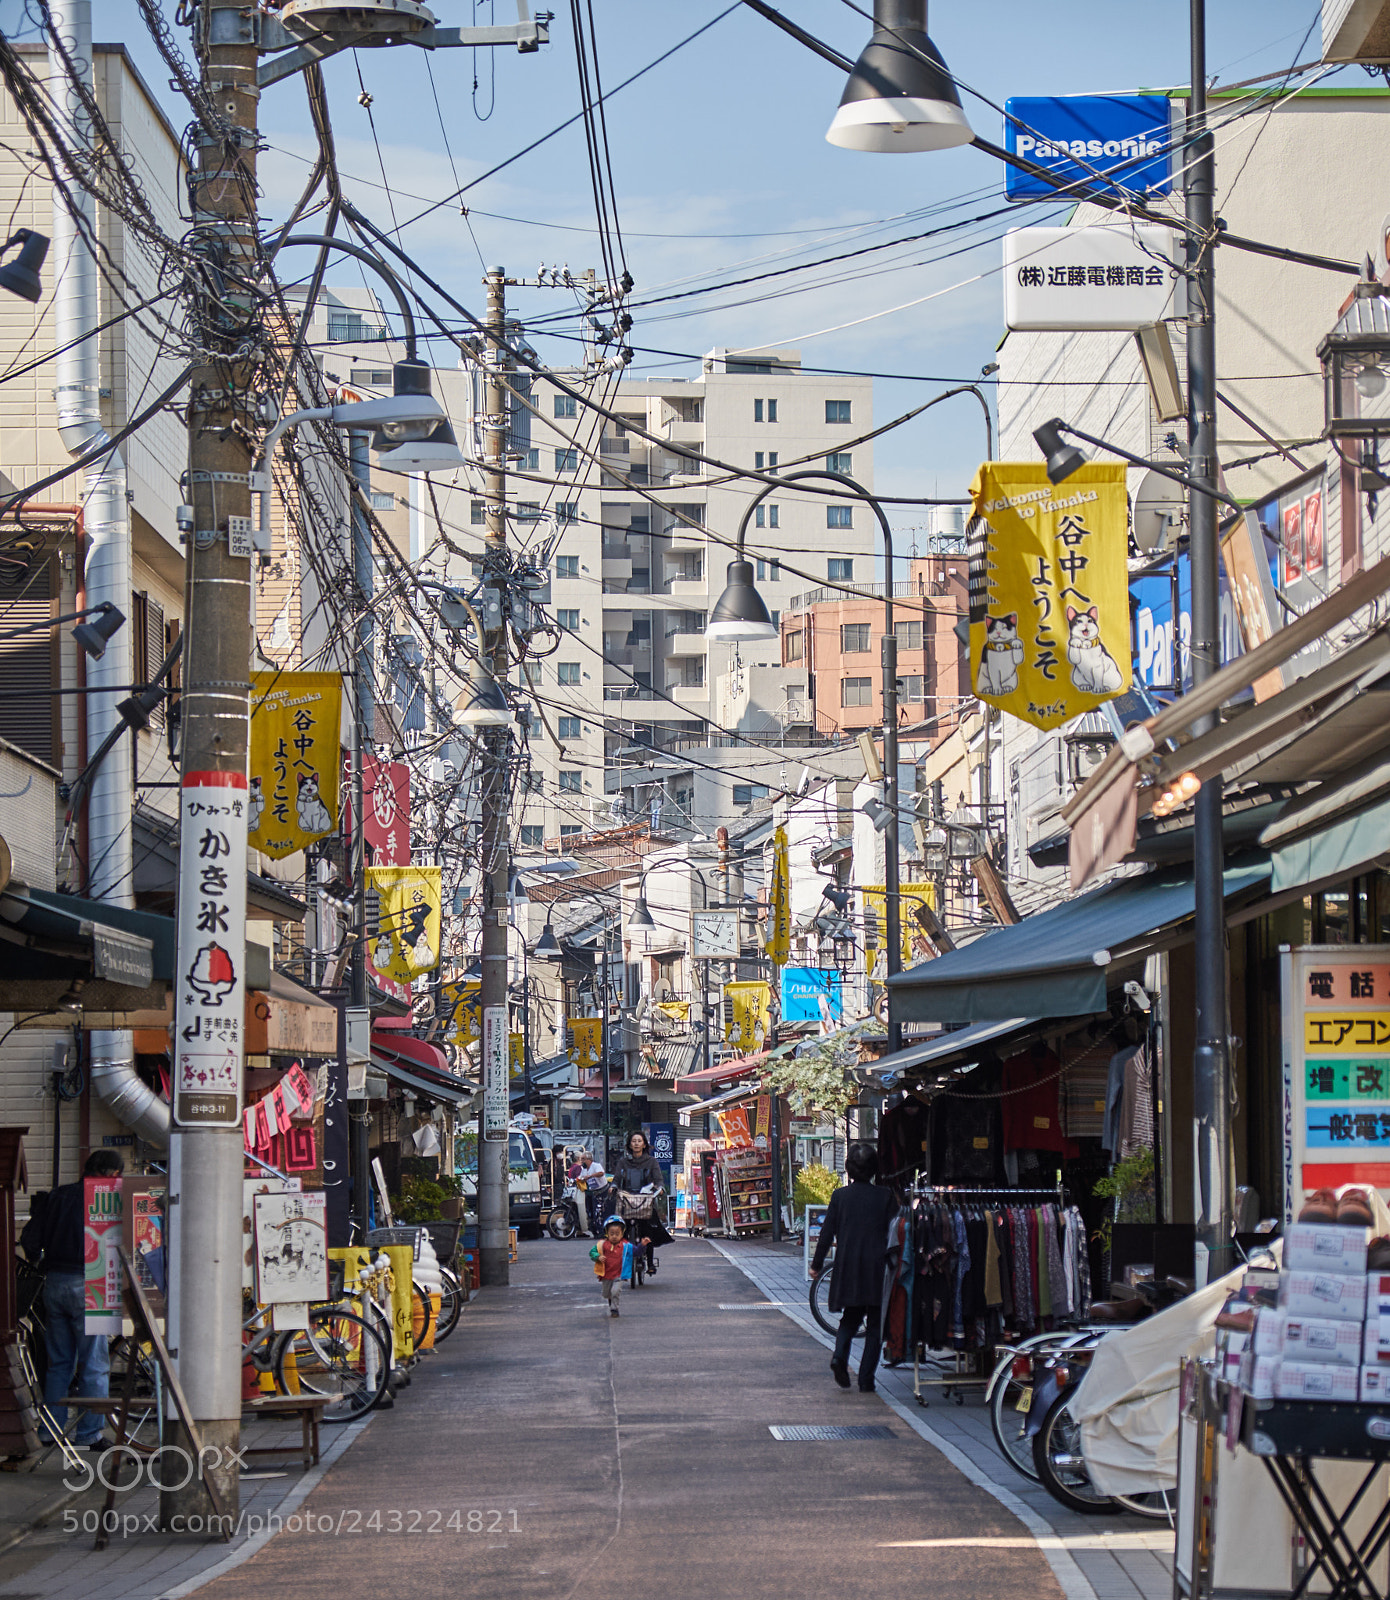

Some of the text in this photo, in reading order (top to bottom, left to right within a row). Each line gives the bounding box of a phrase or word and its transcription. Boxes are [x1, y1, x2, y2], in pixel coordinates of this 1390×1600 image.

[1016, 134, 1164, 158] Panasonic
[1017, 266, 1164, 287] (株)近藤電機商会
[983, 487, 1052, 513] Welcome
[1017, 489, 1099, 520] to Yanaka
[1056, 515, 1091, 603] 谷中へ
[1031, 557, 1059, 680] ようこそ
[249, 689, 290, 705] elcome
[265, 692, 323, 712] to Yanaka
[291, 709, 317, 772] 谷中へ
[271, 738, 290, 824] ようこそ
[187, 800, 244, 818] ひみつ堂
[196, 828, 231, 933] かき氷
[1309, 972, 1390, 999] 電話
[203, 1018, 238, 1029] 手前曲る
[203, 1031, 238, 1043] すぐ先
[191, 1105, 225, 1114] 谷中3-11
